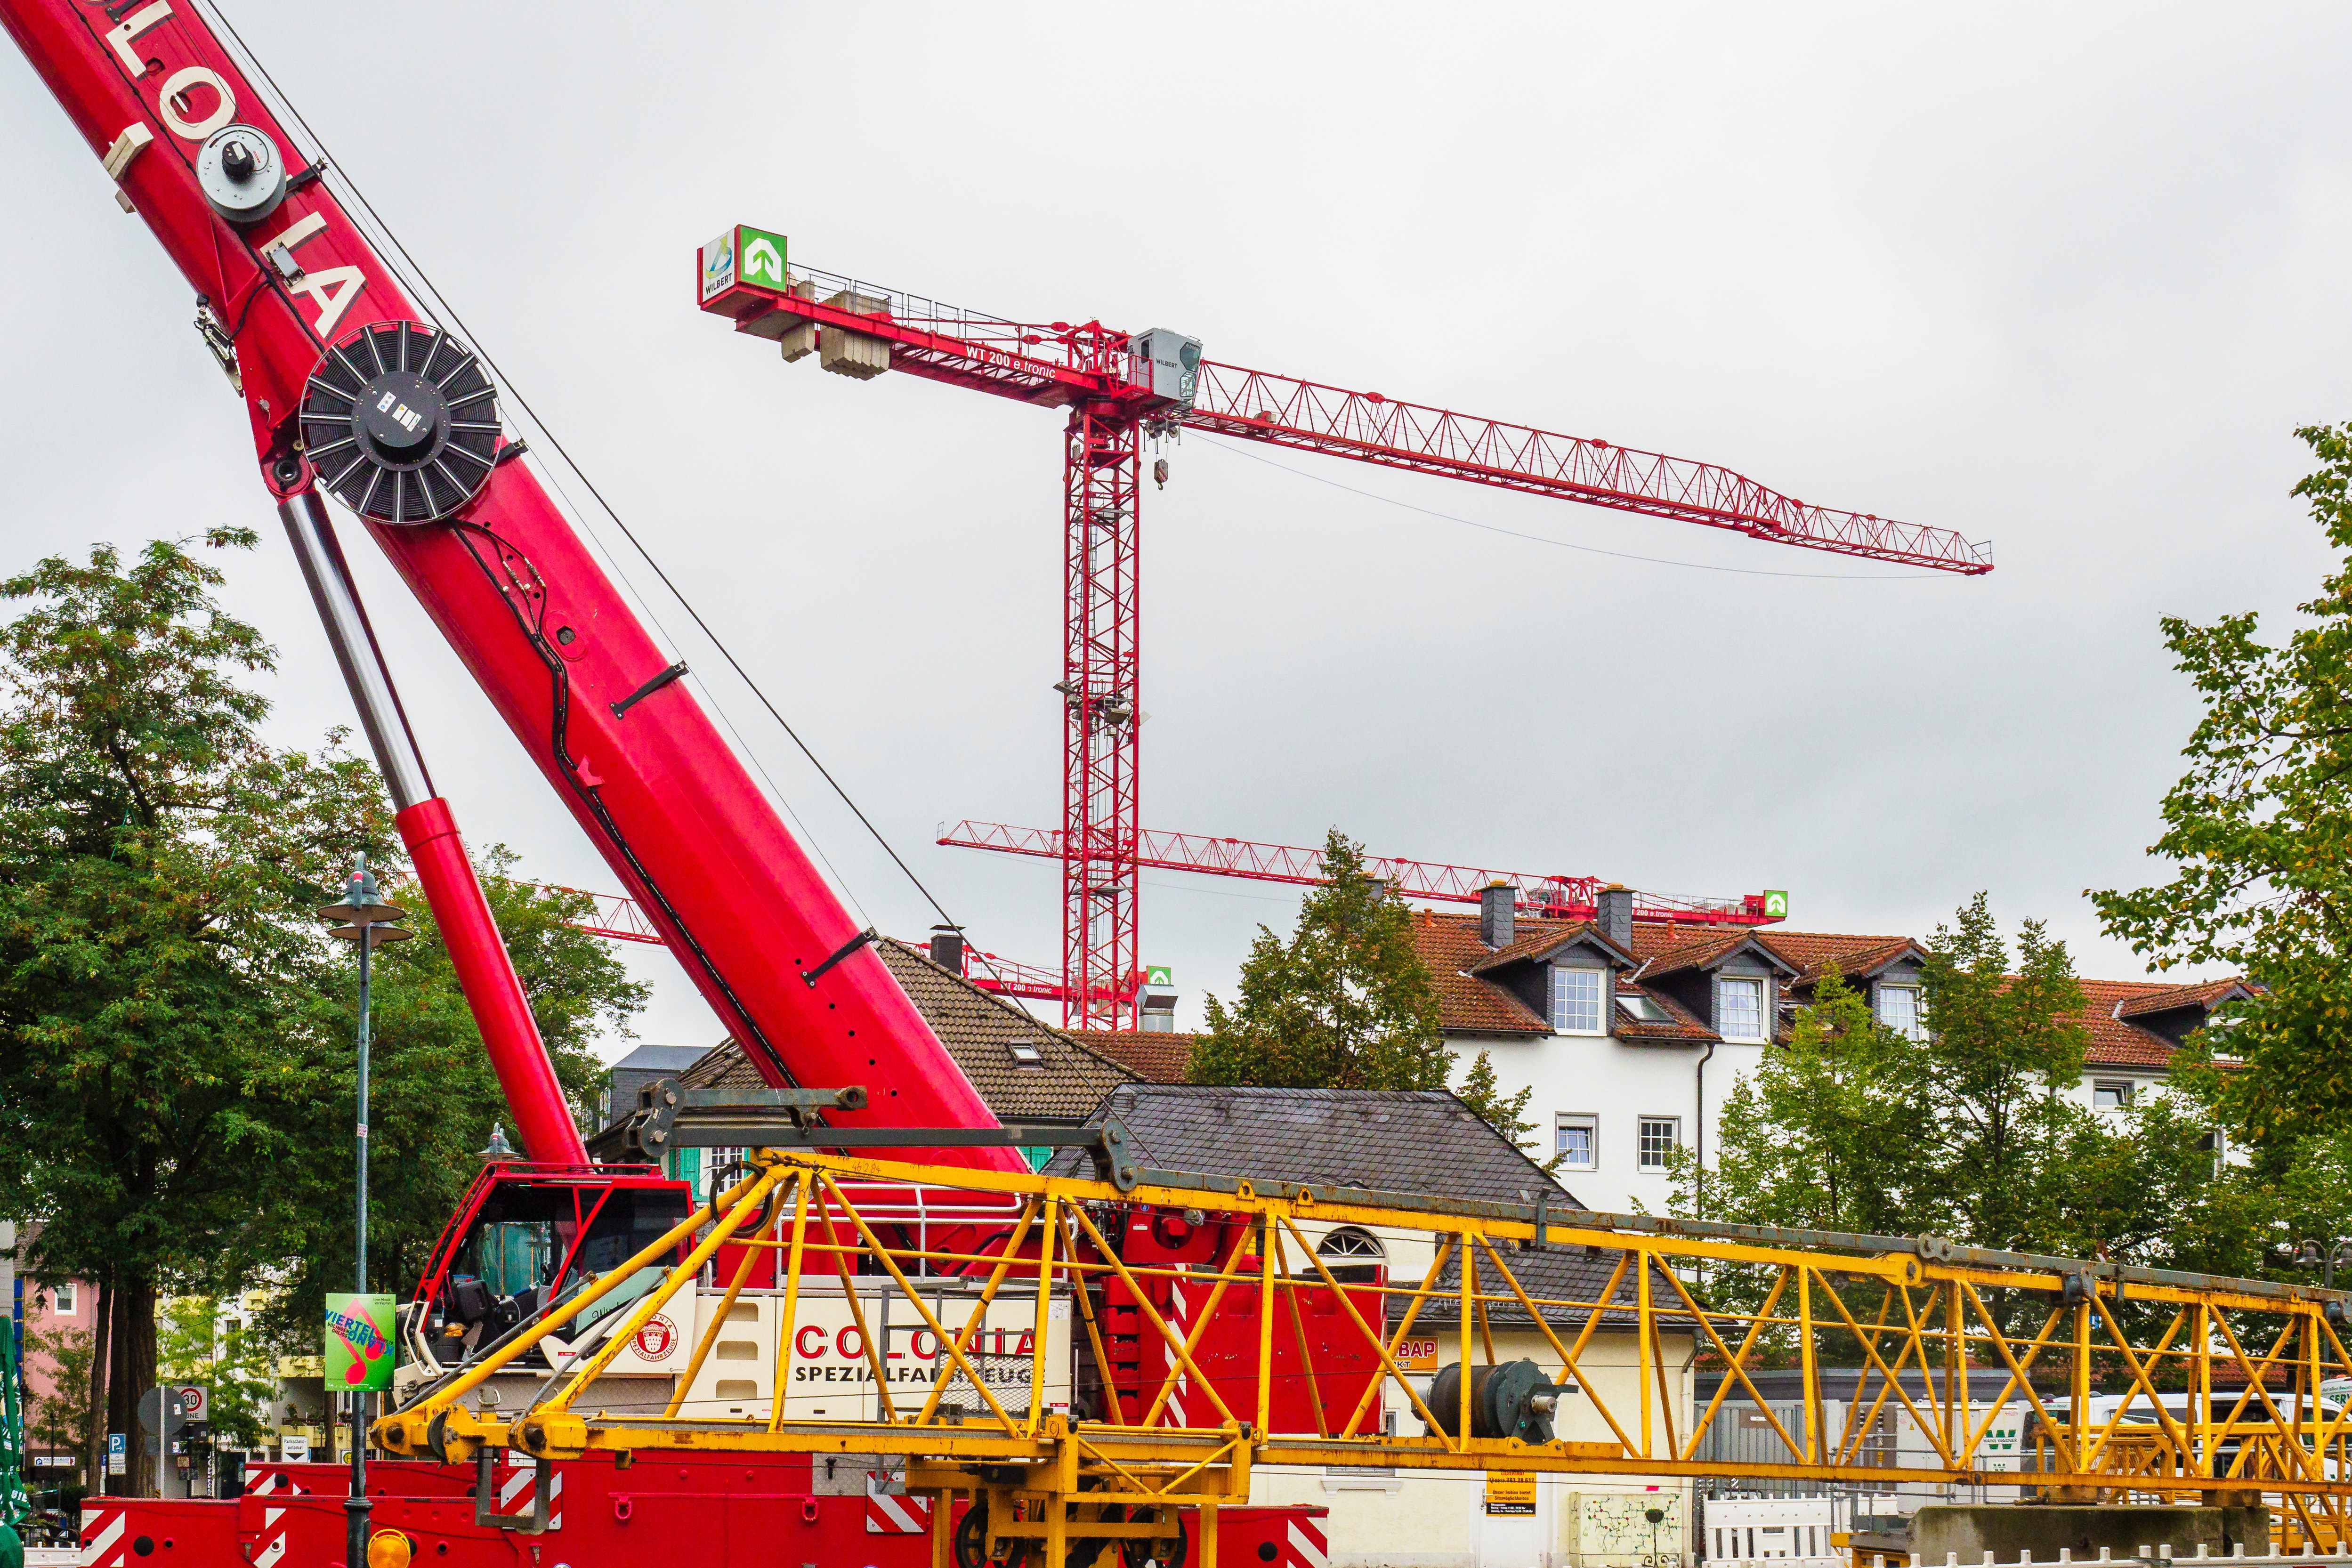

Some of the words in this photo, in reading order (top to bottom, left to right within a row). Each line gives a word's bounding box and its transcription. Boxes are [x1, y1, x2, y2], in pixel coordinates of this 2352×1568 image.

[705, 273, 732, 294] WILBERT
[966, 345, 986, 360] WT
[989, 351, 1010, 367] 200
[1013, 360, 1056, 379] e.tronic
[1156, 358, 1178, 369] WILBERT
[1013, 983, 1026, 991] 200
[325, 1309, 376, 1341] VIERTEL
[1387, 1341, 1436, 1358] BAP
[183, 1394, 197, 1405] 30
[112, 1437, 121, 1451] P
